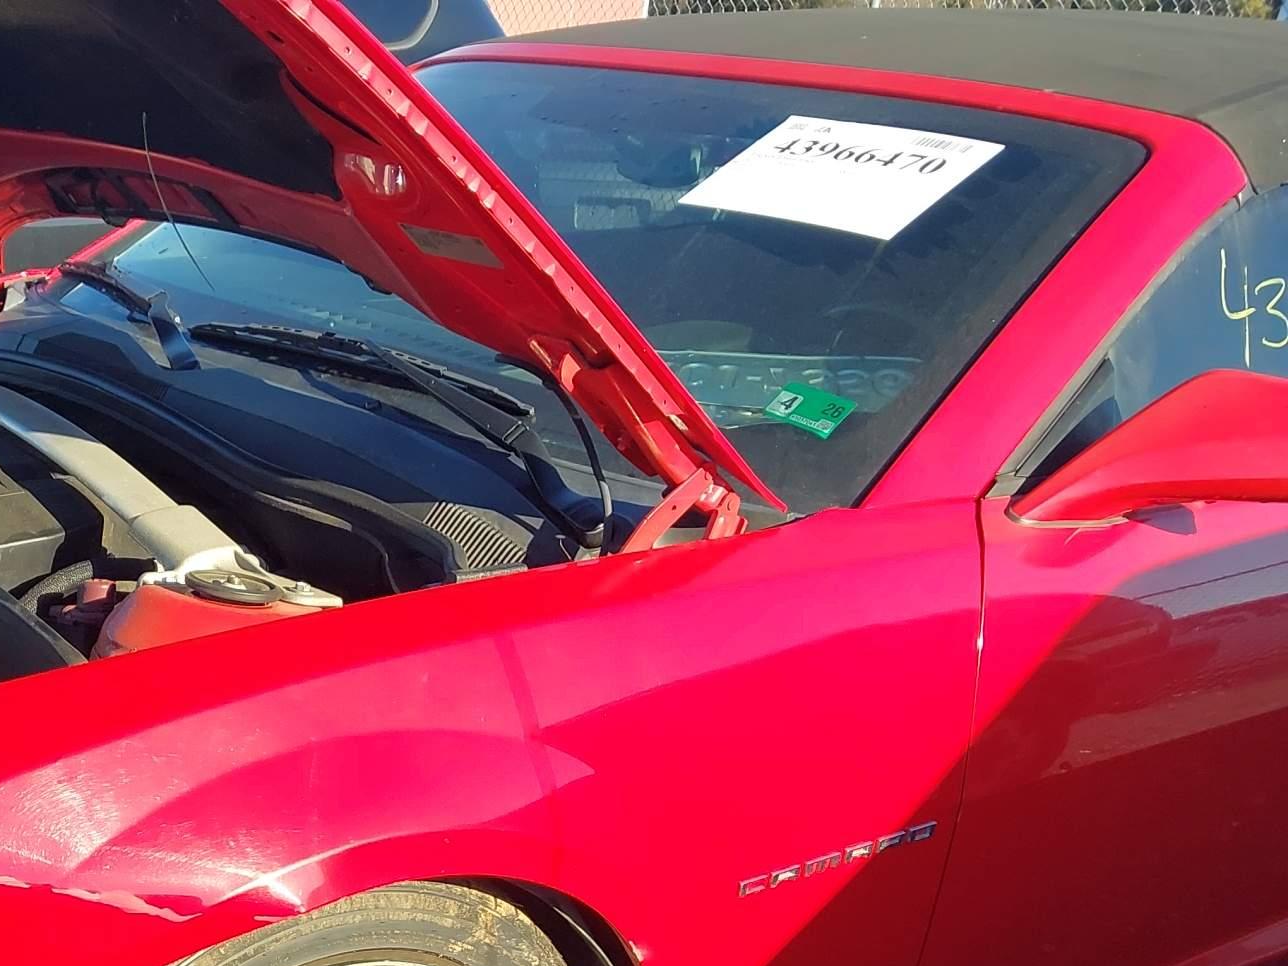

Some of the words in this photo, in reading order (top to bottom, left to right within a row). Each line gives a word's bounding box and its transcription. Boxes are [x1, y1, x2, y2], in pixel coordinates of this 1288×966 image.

[773, 138, 947, 175] 43966470
[1220, 248, 1288, 368] 43
[779, 396, 799, 411] 4
[821, 403, 846, 419] 26
